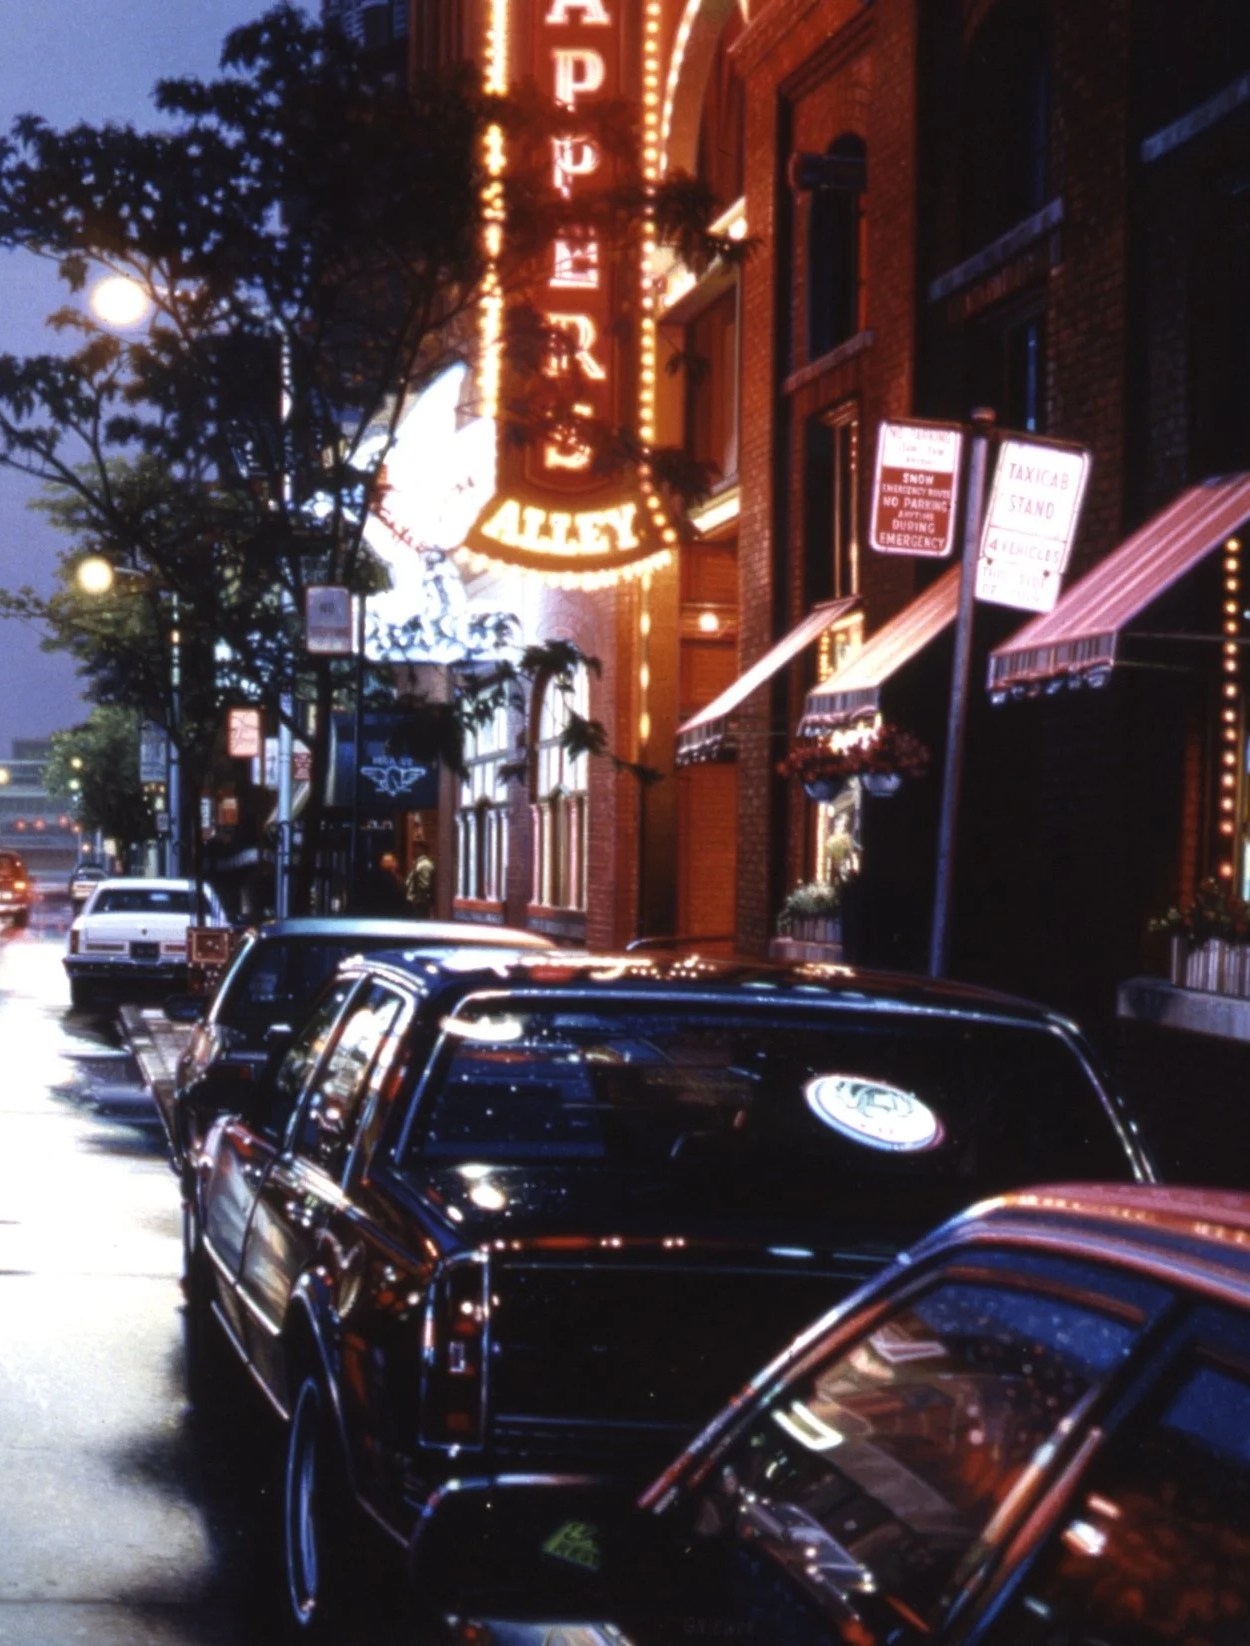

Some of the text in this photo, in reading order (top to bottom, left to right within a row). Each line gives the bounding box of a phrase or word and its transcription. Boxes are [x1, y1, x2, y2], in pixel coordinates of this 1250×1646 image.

[902, 472, 935, 486] SNOW
[1009, 463, 1070, 490] TAXICAB
[883, 496, 948, 513] NO PARKING
[1008, 494, 1055, 520] STAND
[481, 499, 639, 556] ALLEY
[892, 519, 935, 534] DURING
[879, 532, 945, 549] EMERGENCY
[1002, 542, 1061, 564] VEHICLES
